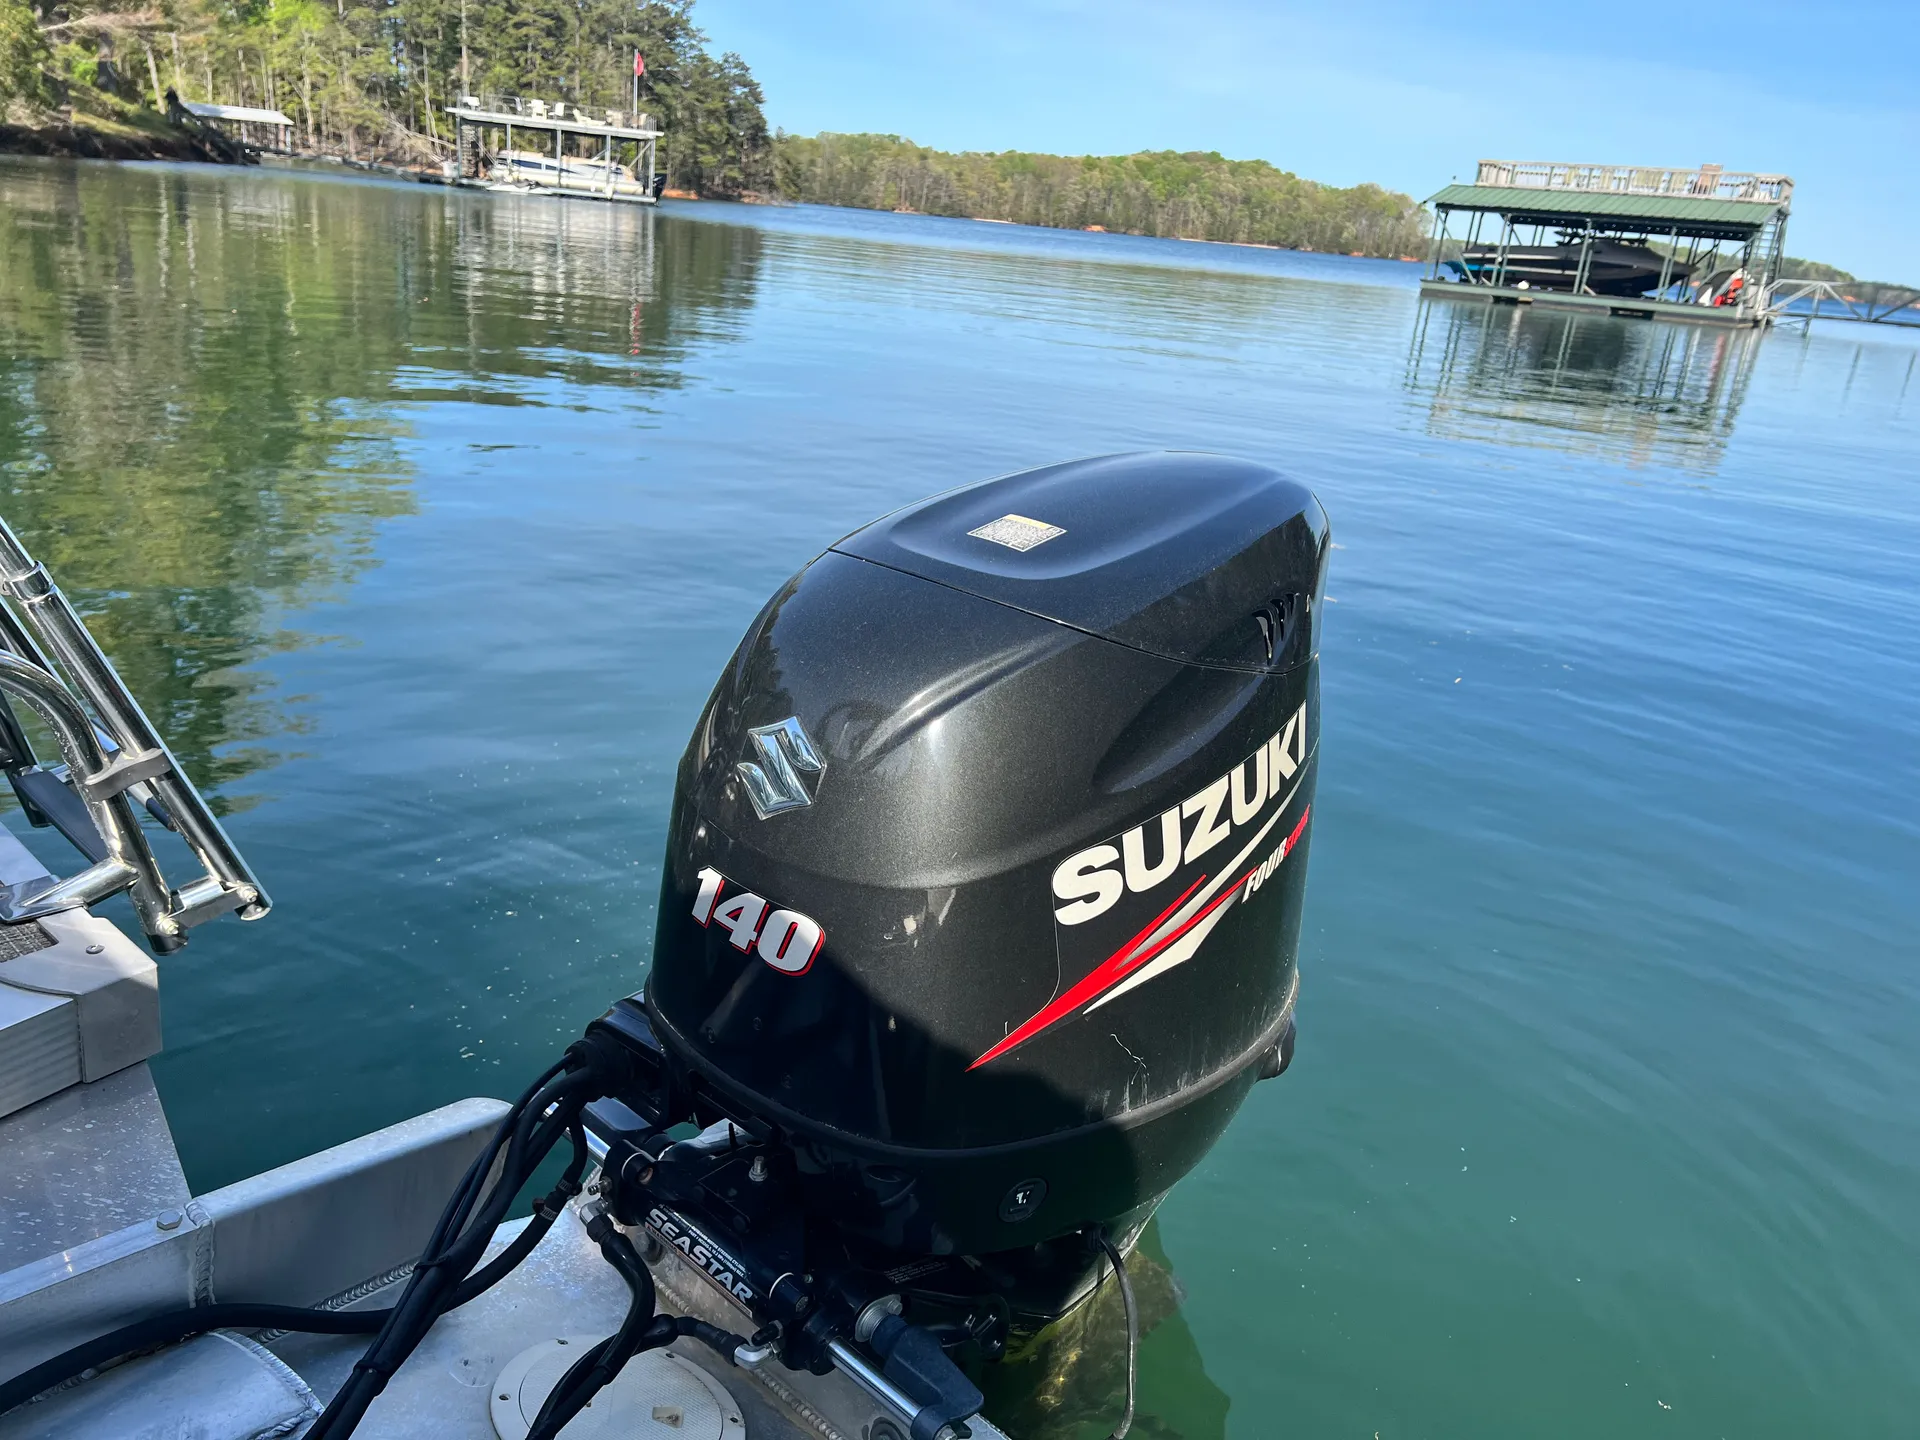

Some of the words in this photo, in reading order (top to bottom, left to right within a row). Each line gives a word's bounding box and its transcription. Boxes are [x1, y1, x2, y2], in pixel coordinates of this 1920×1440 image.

[1053, 699, 1307, 926] SUZUKI
[691, 865, 826, 976] 140
[645, 1208, 753, 1304] SEASTAR
